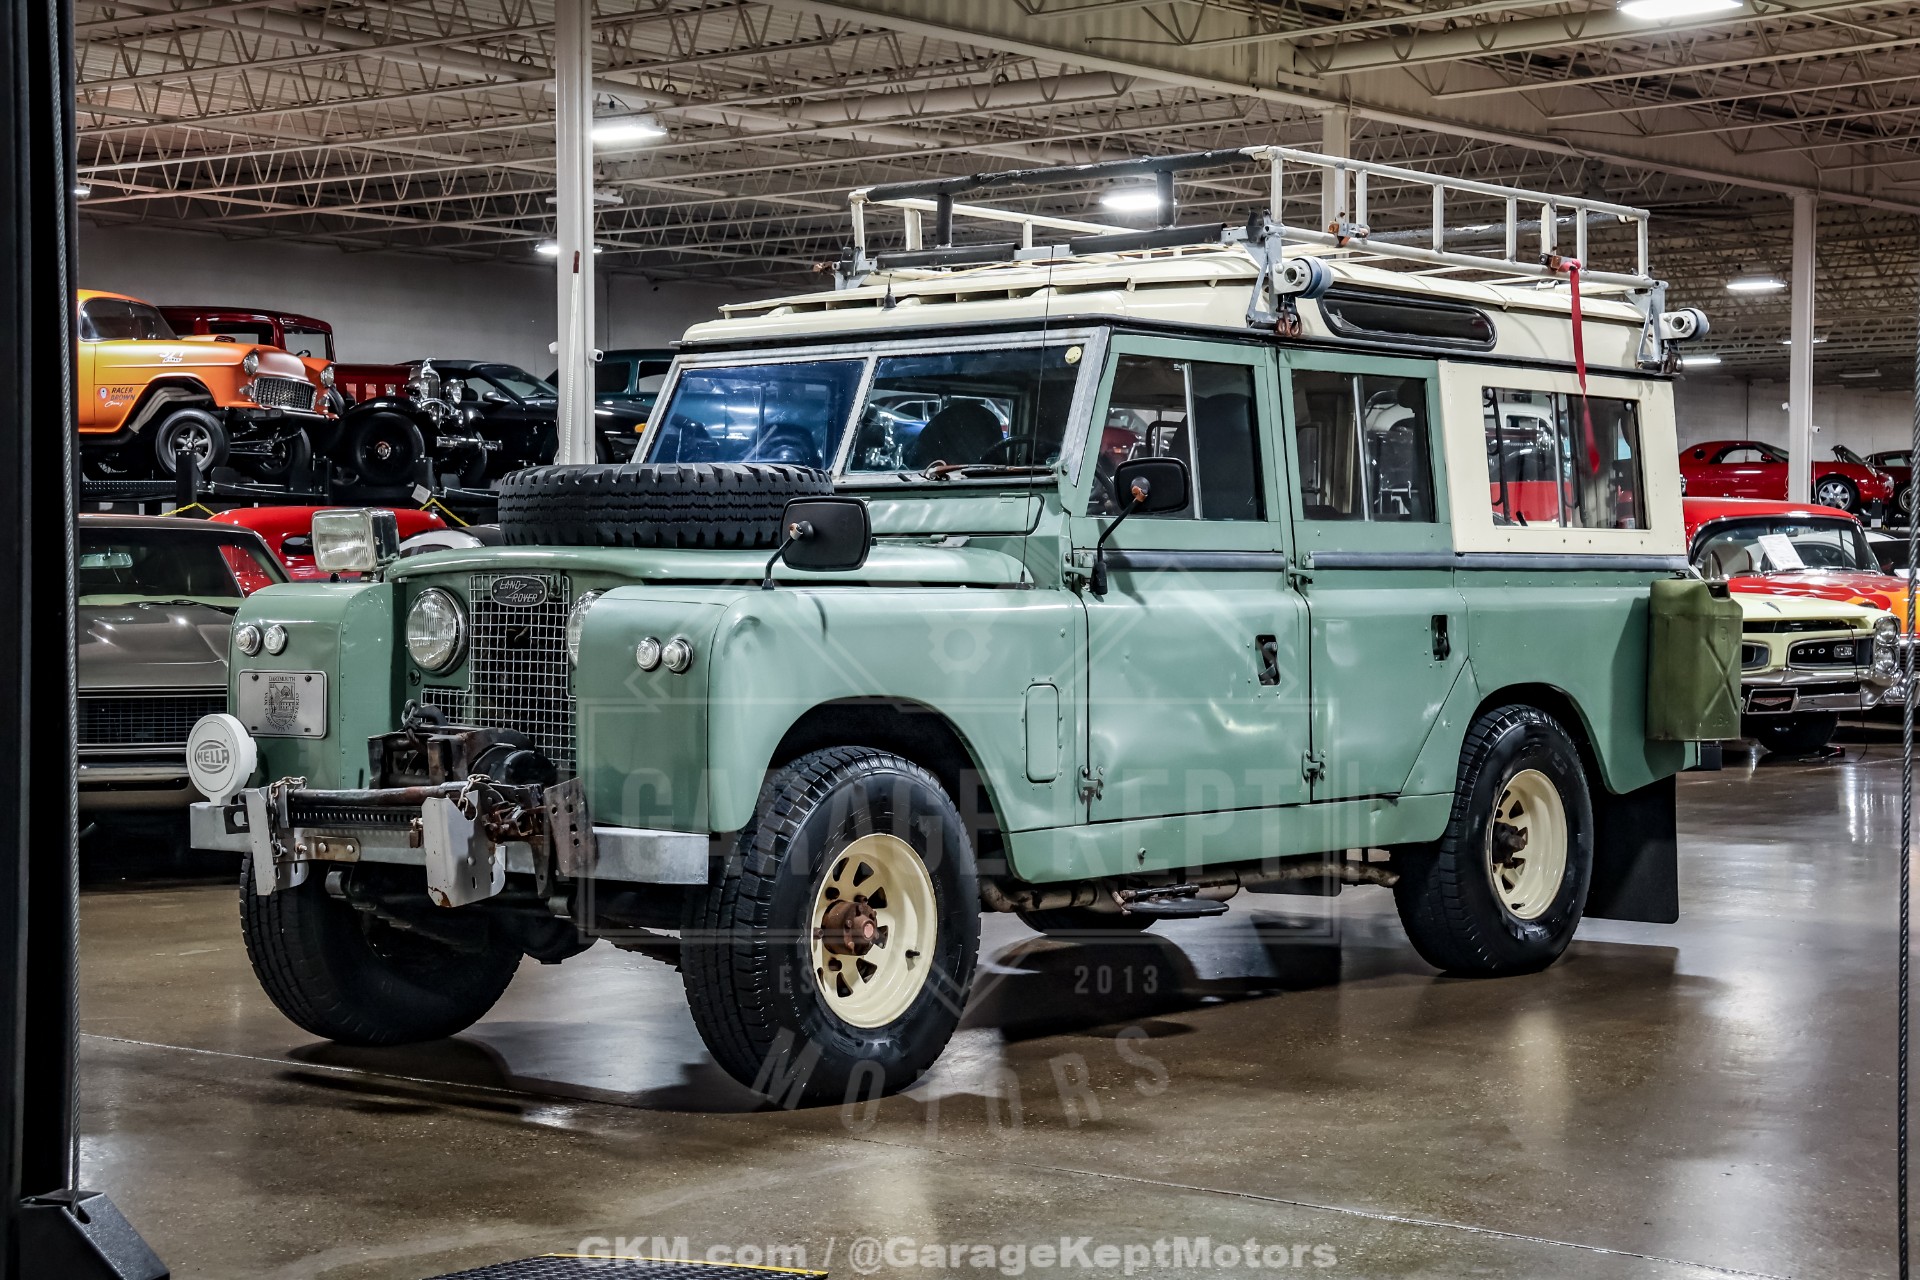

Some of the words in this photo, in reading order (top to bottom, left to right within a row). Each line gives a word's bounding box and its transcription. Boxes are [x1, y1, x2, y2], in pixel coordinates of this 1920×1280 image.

[500, 580, 521, 590] LAND
[511, 593, 538, 603] ROVER
[1797, 647, 1826, 655] GTO
[197, 749, 230, 764] HELLA
